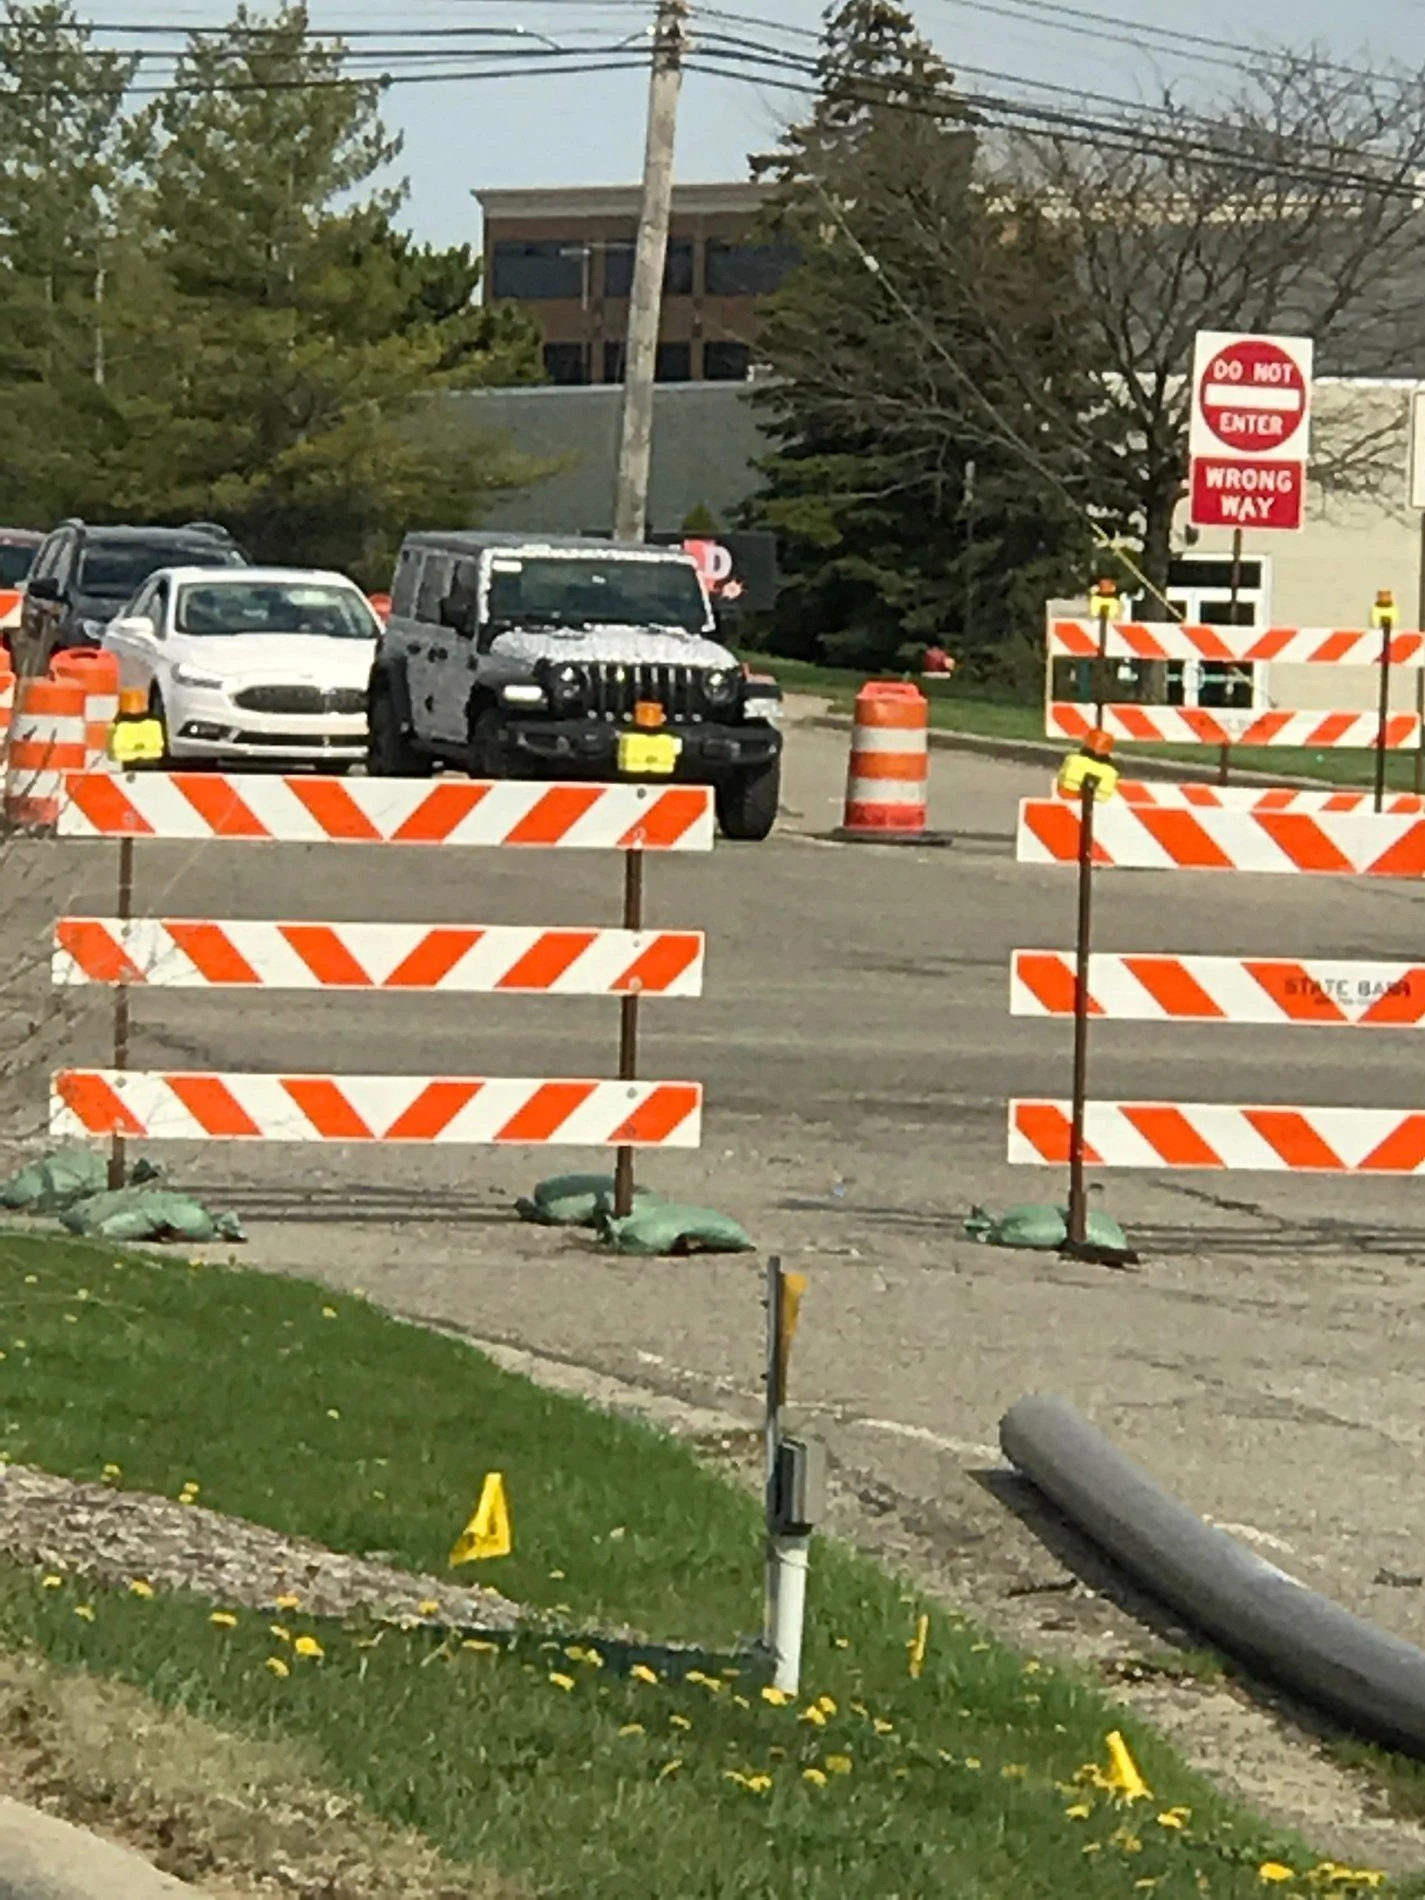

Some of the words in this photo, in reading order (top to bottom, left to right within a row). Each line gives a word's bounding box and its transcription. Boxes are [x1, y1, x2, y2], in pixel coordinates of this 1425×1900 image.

[1213, 359, 1244, 381] DO
[1253, 362, 1293, 384] NOT
[1219, 411, 1284, 436] ENTER
[1205, 465, 1293, 493] WRONG
[1221, 495, 1275, 519] WAY
[1284, 978, 1349, 997] STATE
